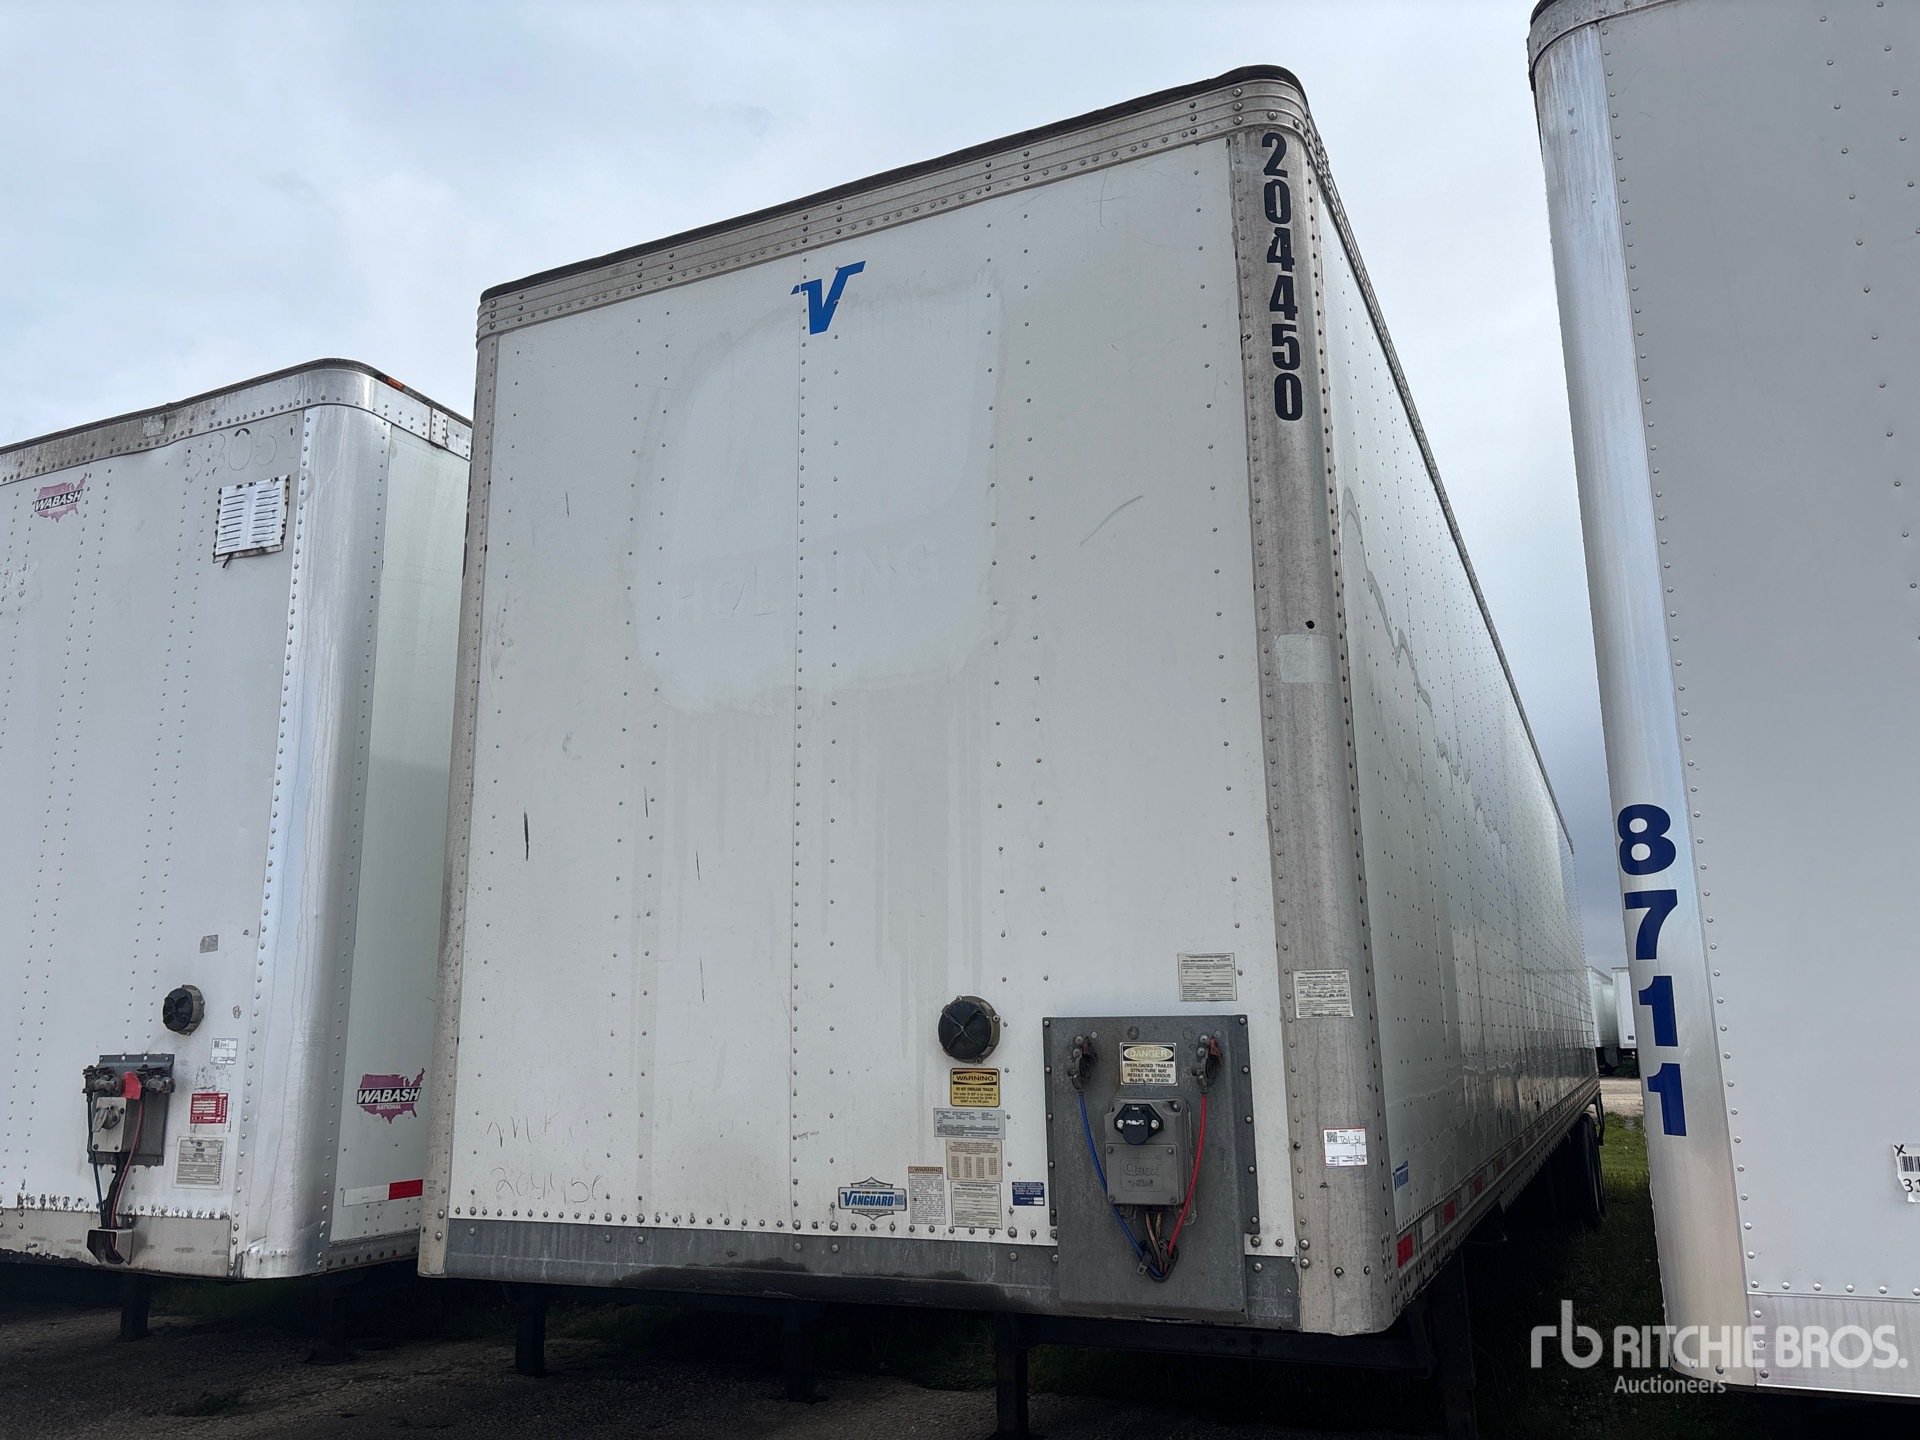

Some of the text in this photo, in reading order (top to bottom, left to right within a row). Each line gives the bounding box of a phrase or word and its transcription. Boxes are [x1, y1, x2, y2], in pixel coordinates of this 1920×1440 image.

[1261, 137, 1303, 421] 204450
[34, 490, 83, 511] WABASH
[1617, 803, 1687, 1137] 8711
[1129, 1049, 1168, 1058] DANGER
[357, 1088, 422, 1104] WABASH
[841, 1190, 895, 1207] VANGUARD
